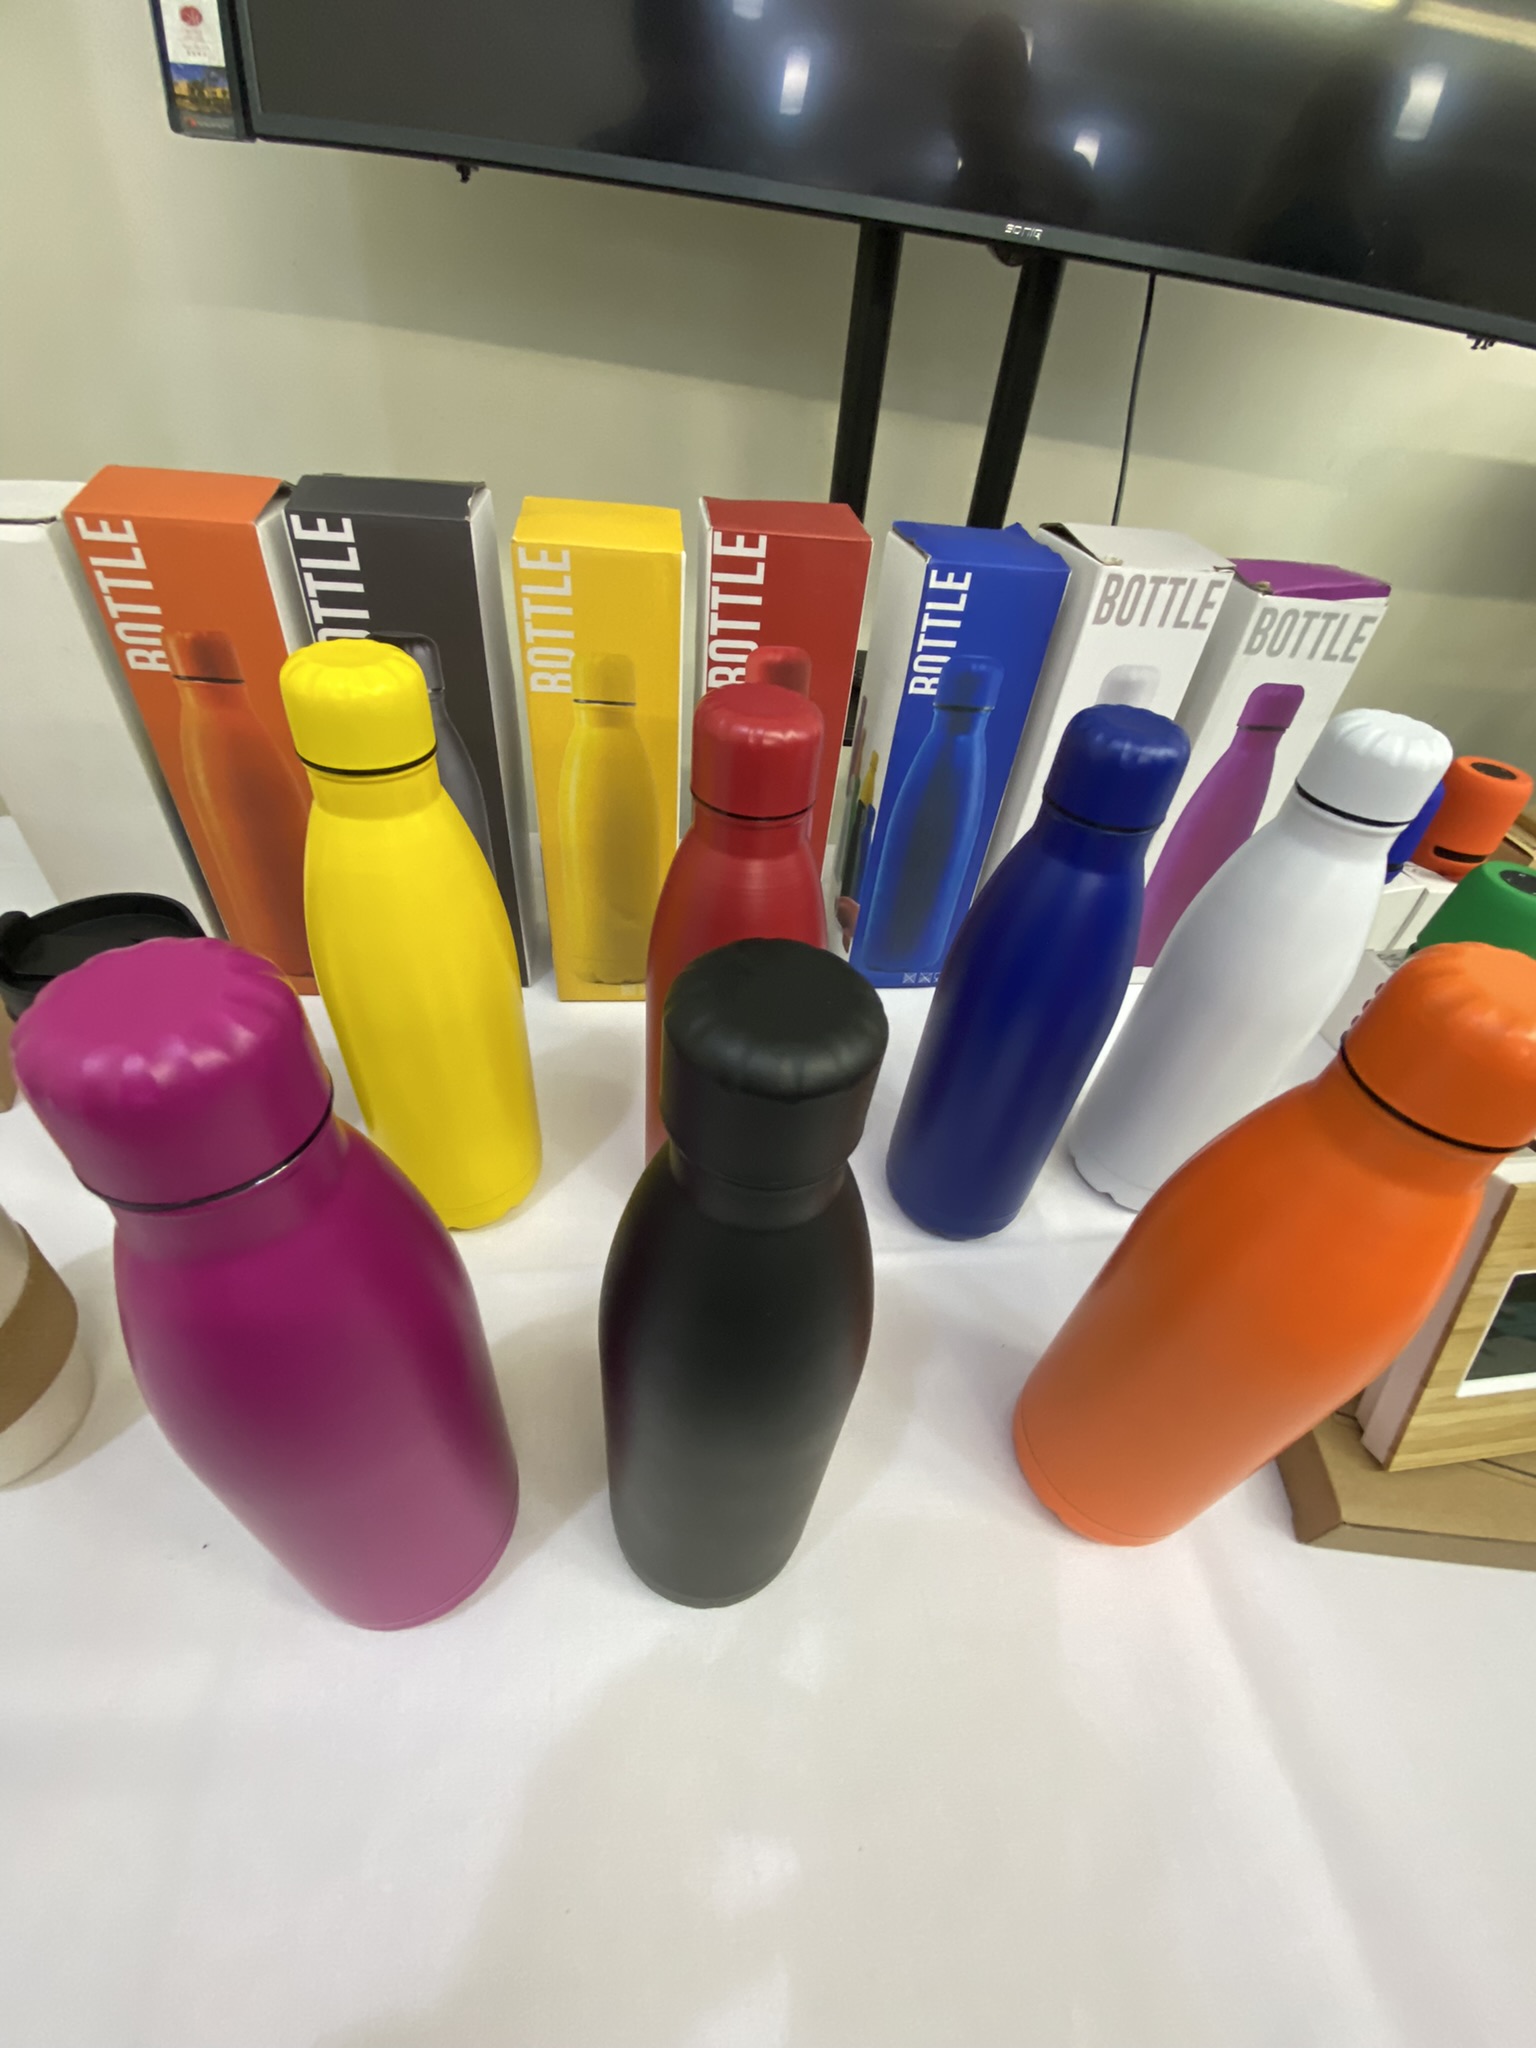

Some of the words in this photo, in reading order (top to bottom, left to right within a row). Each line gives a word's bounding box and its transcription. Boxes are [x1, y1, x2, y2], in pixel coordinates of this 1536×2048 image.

[75, 516, 171, 673] BOTTLE
[518, 546, 576, 694] BOTTLE
[707, 531, 767, 689] BOTTLE
[908, 569, 972, 696] BOTTLE
[1092, 573, 1226, 631] BOTTLE
[1243, 607, 1379, 664] BOTTLE
